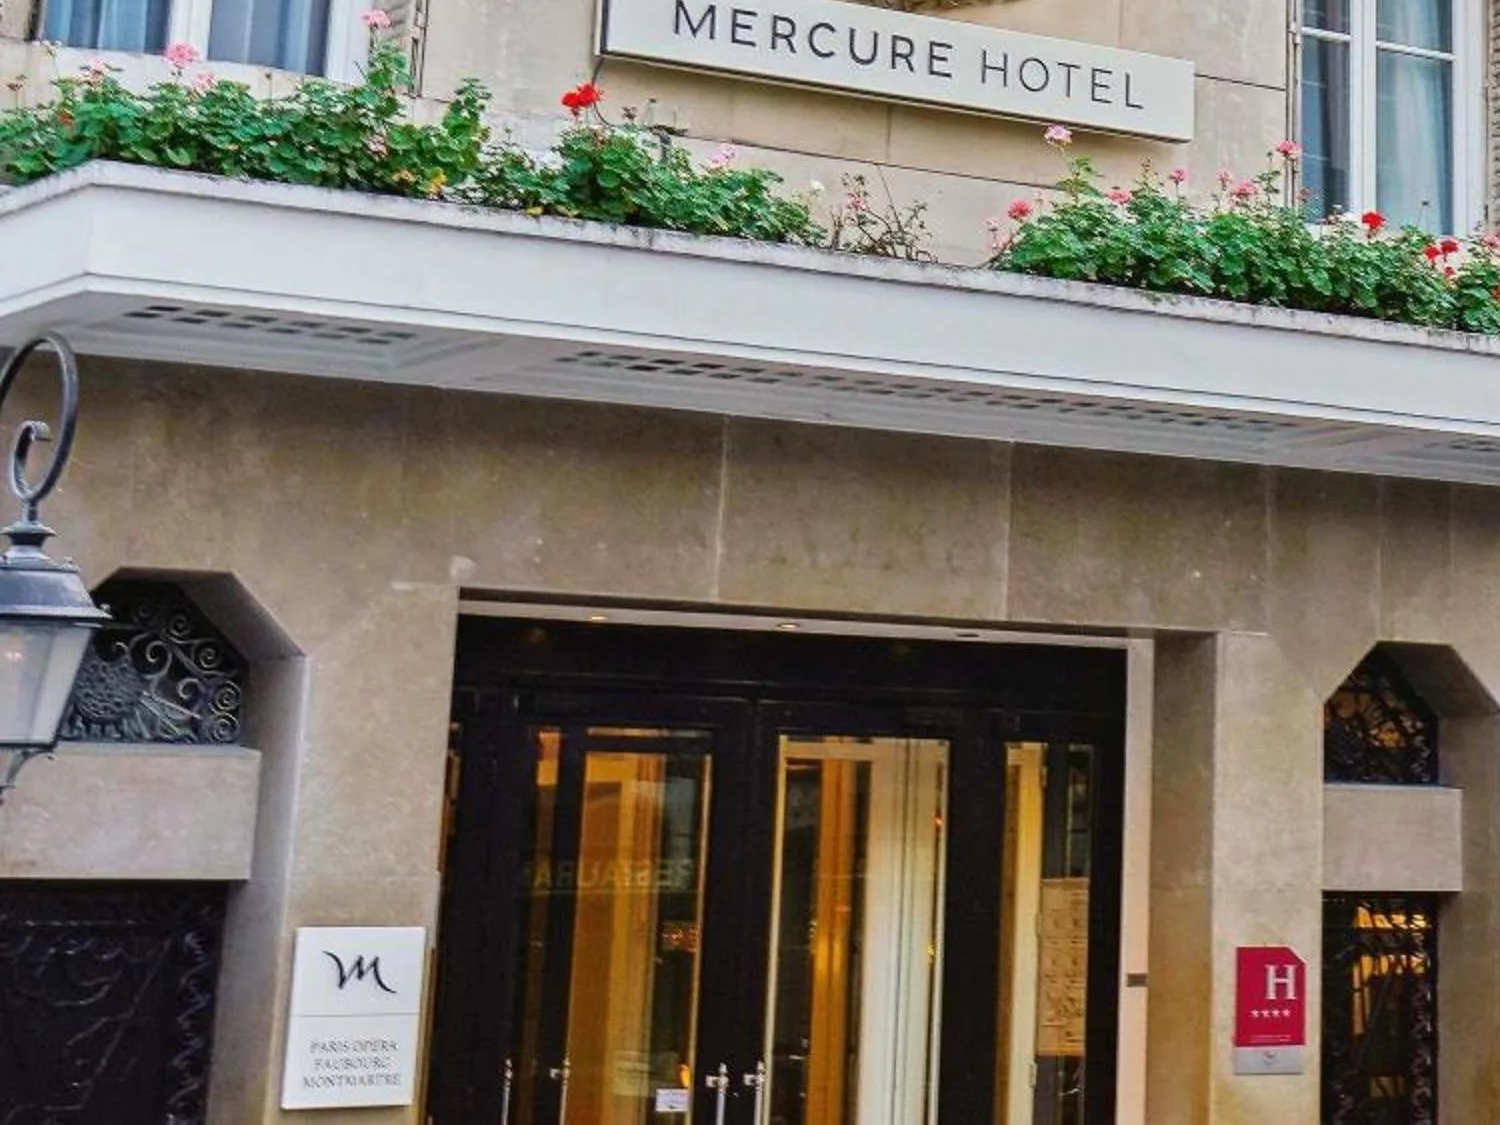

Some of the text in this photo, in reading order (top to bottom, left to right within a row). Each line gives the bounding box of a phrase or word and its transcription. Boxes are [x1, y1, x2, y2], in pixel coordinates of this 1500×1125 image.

[981, 49, 1145, 110] HOTEL
[1264, 964, 1297, 1000] H
[309, 1039, 349, 1054] PARIS
